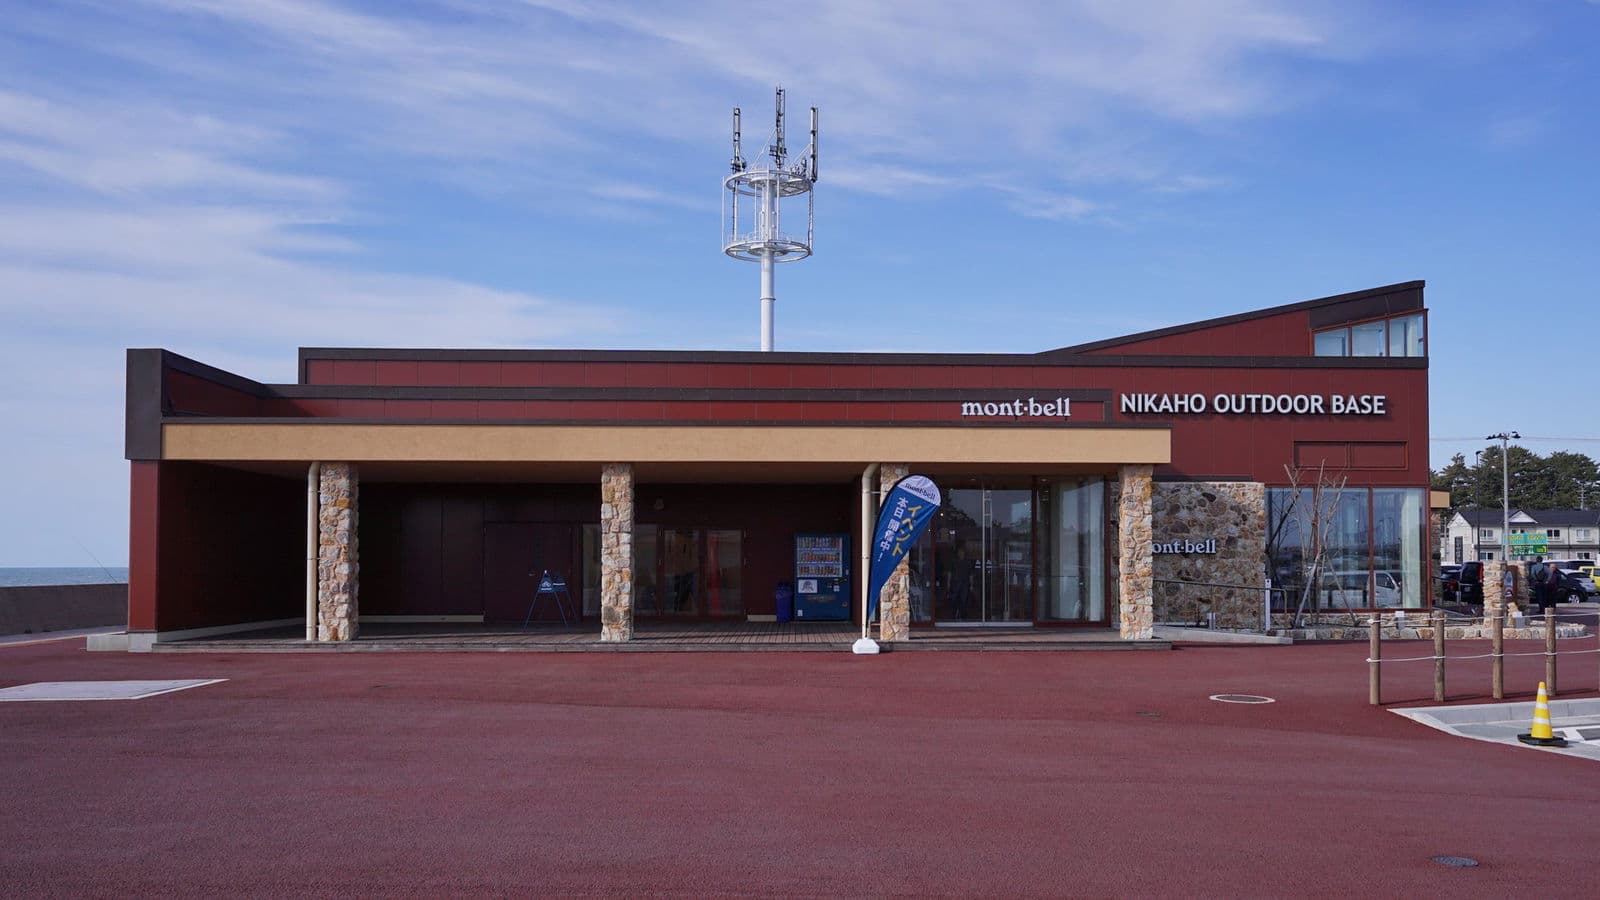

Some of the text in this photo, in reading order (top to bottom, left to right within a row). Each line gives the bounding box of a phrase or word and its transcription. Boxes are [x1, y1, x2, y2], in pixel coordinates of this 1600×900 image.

[1120, 393, 1386, 414] NIKAHO OUTDOOR BASE
[891, 504, 922, 557] イベント
[1152, 539, 1217, 554] ont·bell
